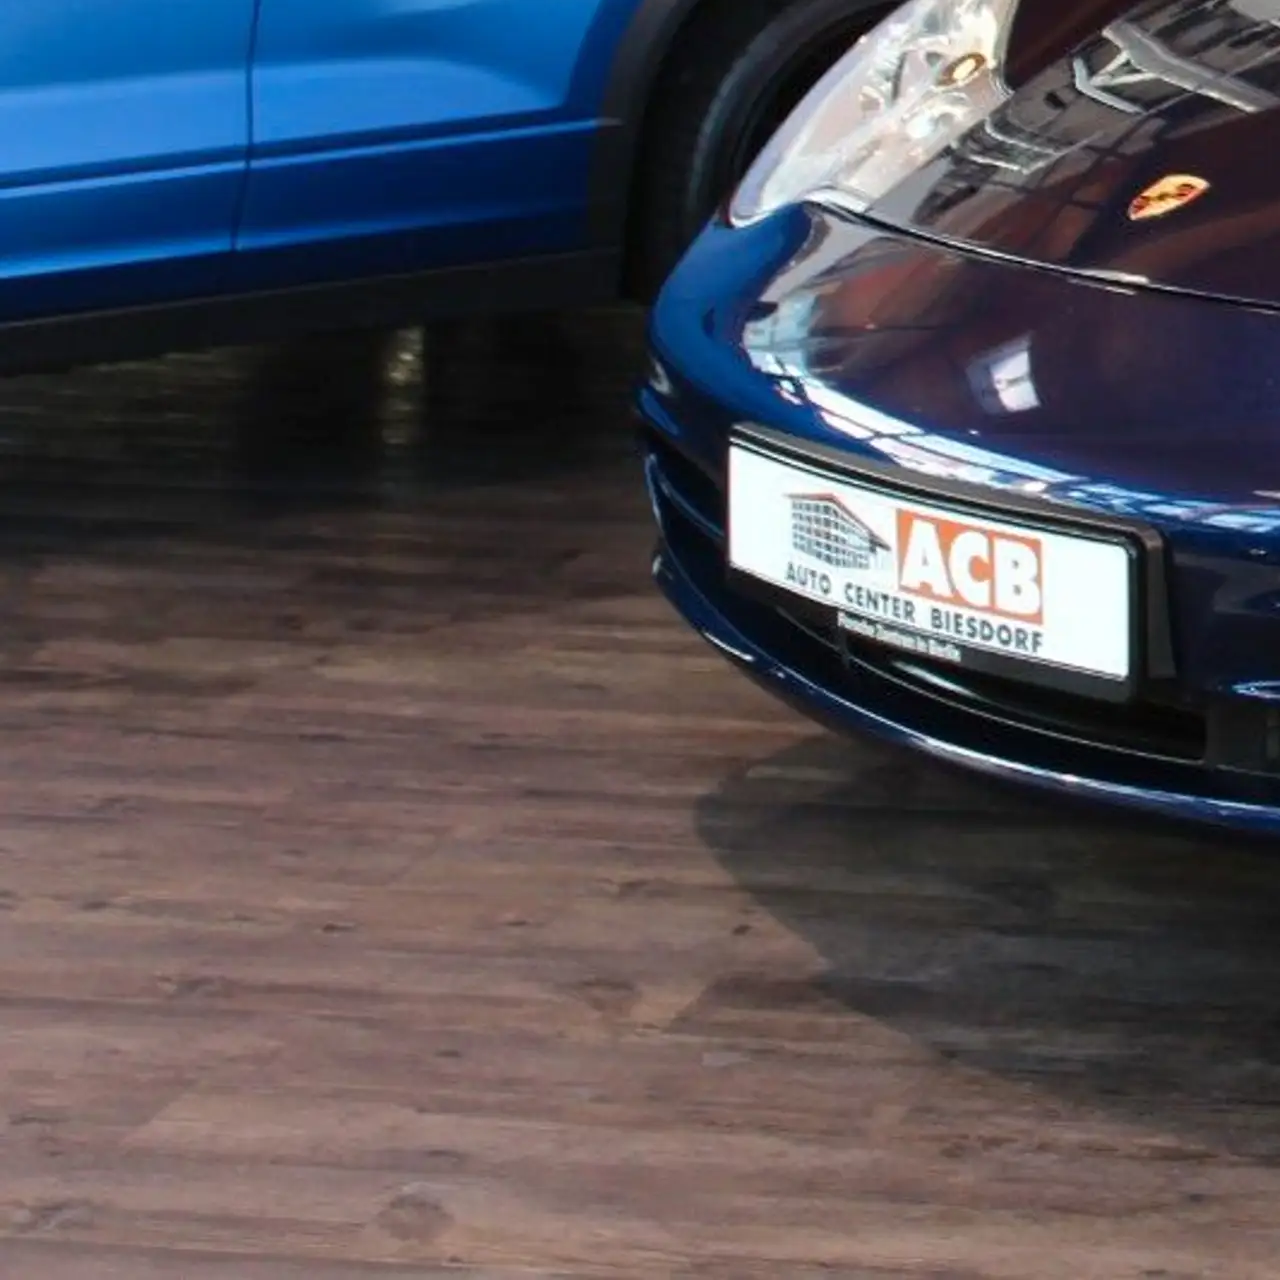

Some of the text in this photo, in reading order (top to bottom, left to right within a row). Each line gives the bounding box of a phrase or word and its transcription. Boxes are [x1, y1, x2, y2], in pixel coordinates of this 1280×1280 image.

[786, 561, 832, 596] AUTO
[844, 581, 916, 624] CENTER
[931, 607, 1043, 653] BIESDORF
[902, 519, 1041, 615] ACB
